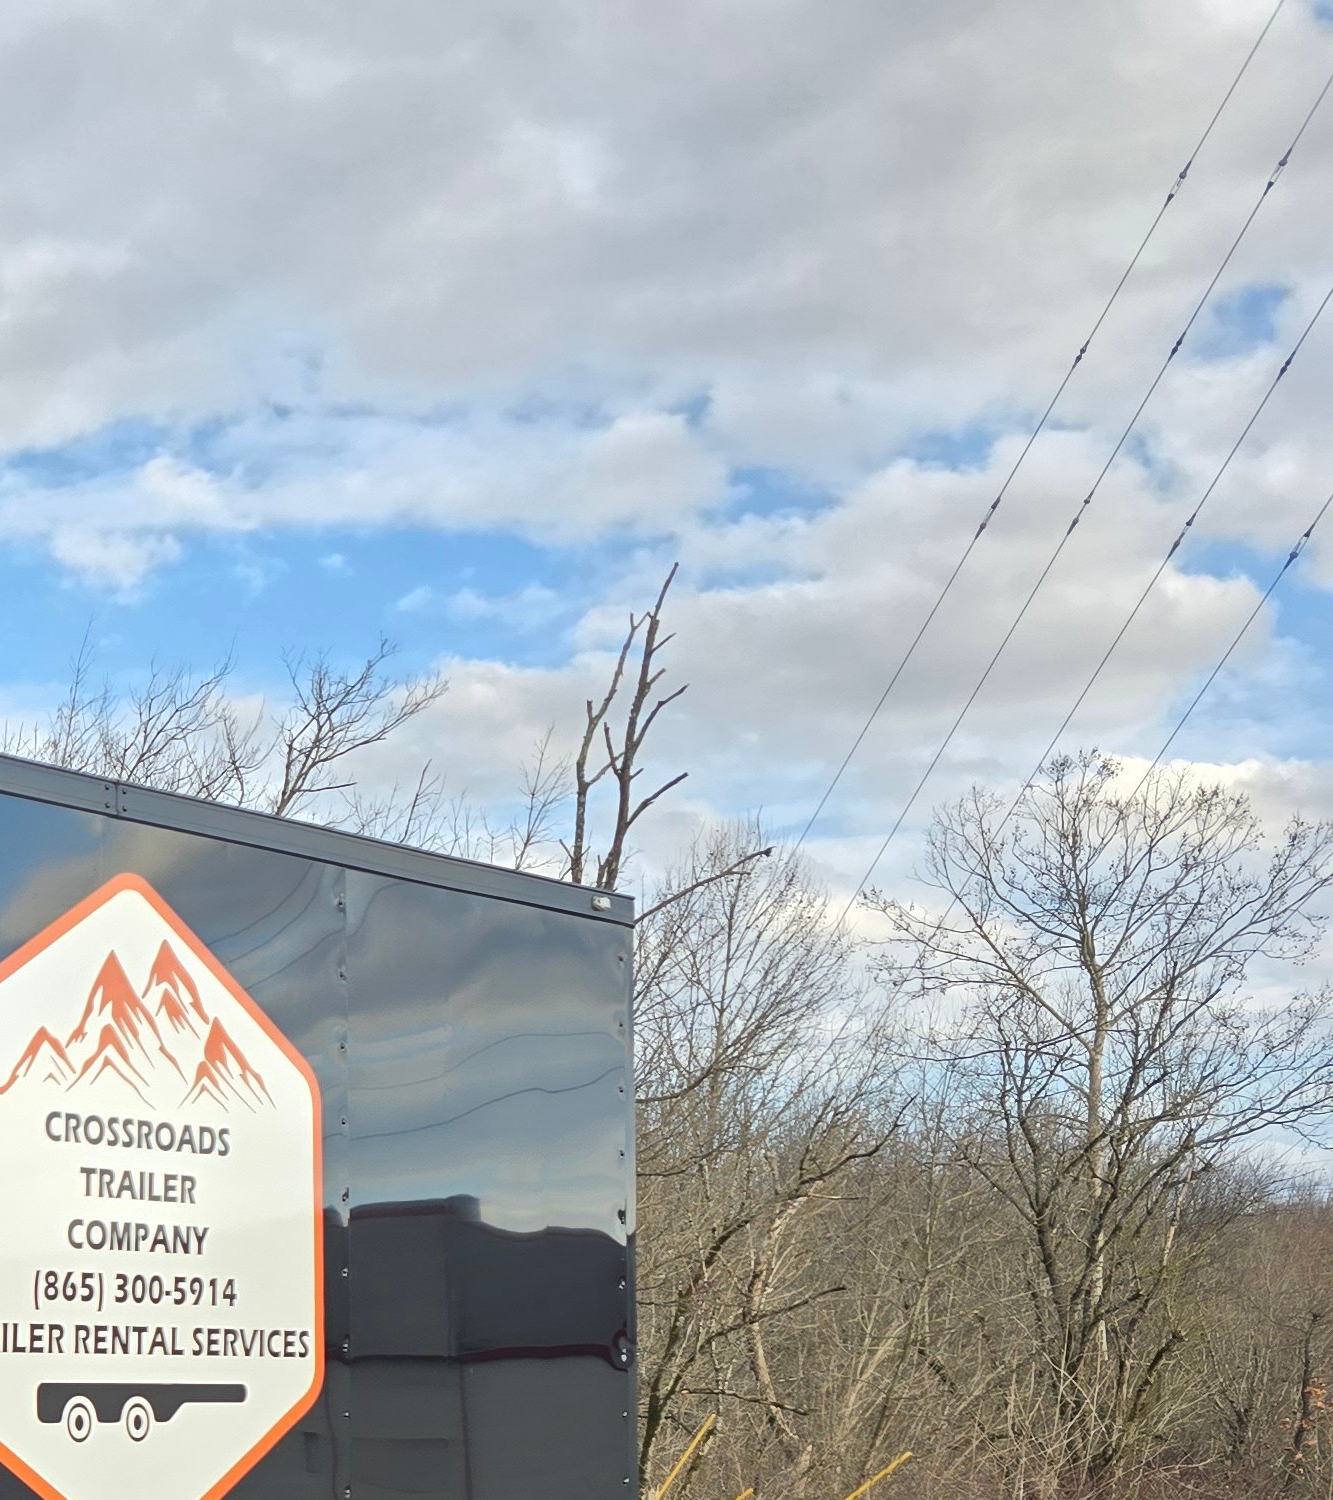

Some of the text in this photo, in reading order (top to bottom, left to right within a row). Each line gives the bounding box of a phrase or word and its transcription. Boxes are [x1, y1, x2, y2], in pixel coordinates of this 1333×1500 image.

[45, 1110, 231, 1157] CROSSROADS
[80, 1166, 197, 1204] TRAILER
[67, 1218, 209, 1255] COMPANY
[34, 1270, 238, 1311] (865) 300-5914
[74, 1324, 184, 1357] RENTAL
[192, 1328, 311, 1359] SERVICES
